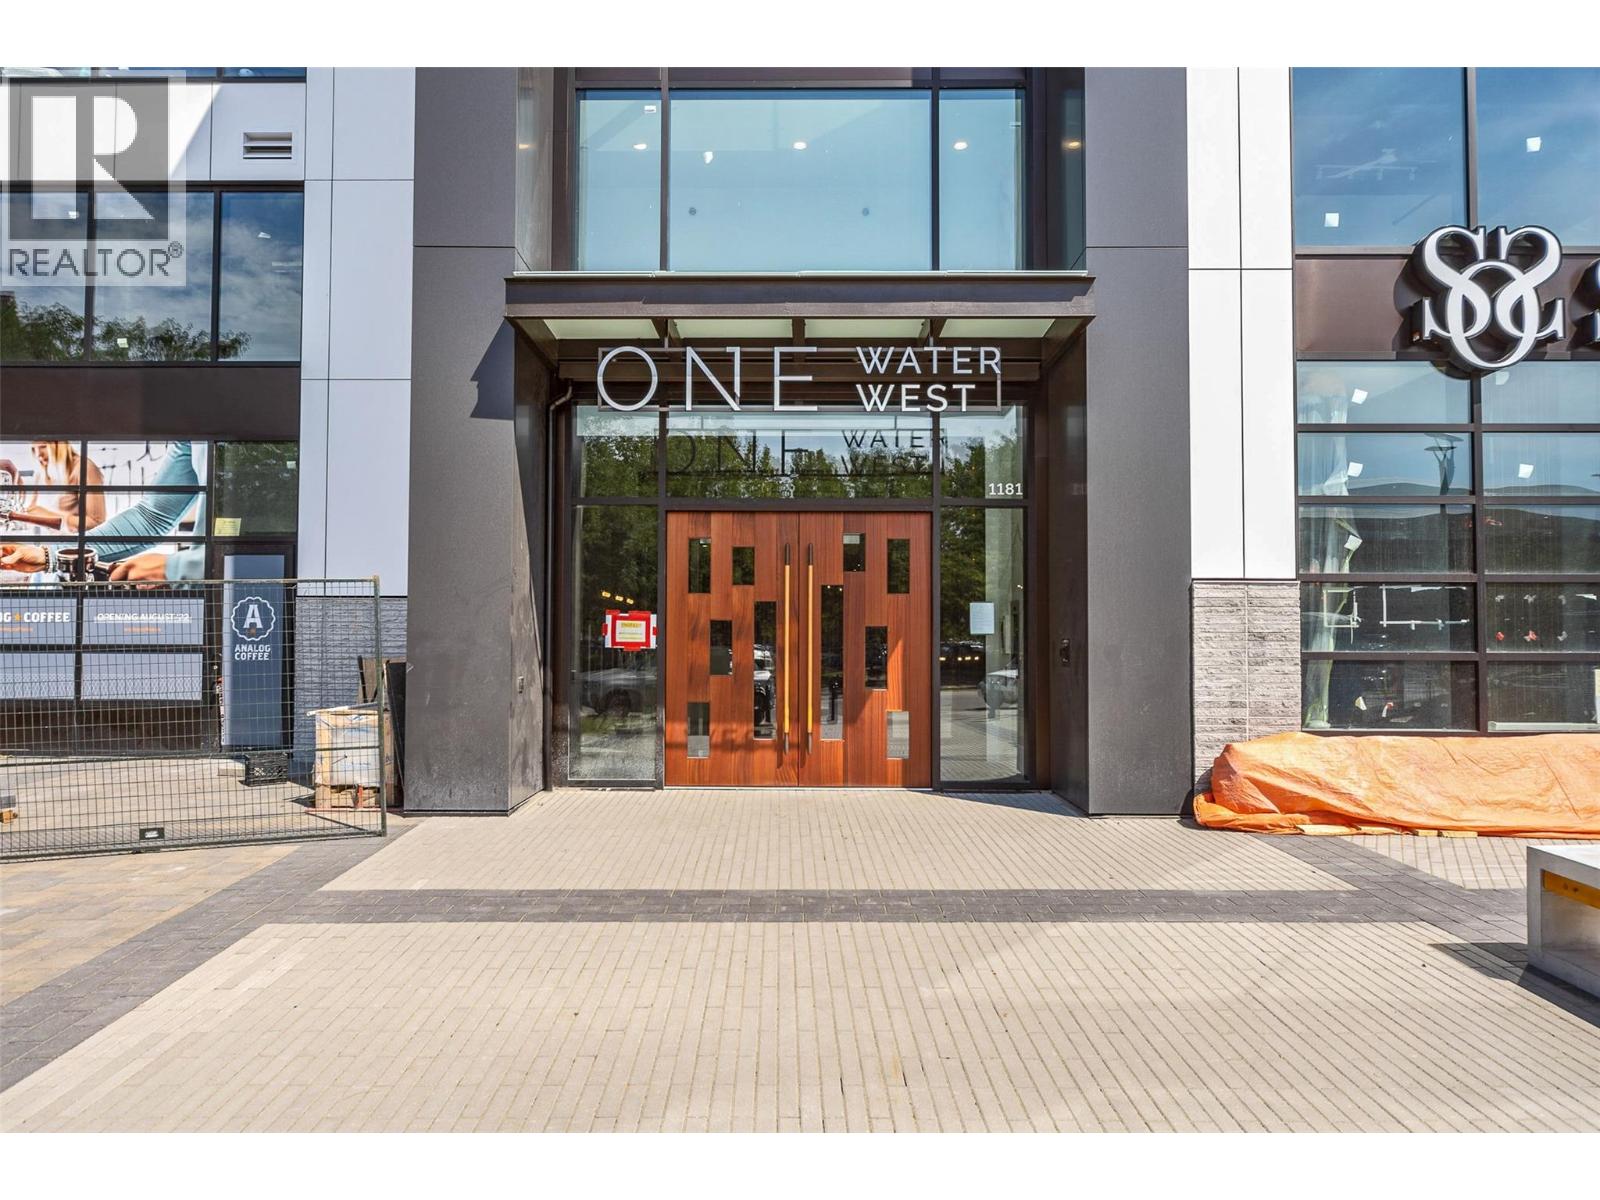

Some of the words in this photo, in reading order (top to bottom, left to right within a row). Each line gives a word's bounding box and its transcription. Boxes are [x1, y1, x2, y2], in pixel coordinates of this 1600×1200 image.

[856, 346, 1001, 375] WATER
[597, 345, 818, 412] ONE
[856, 384, 976, 413] WEST
[989, 482, 1024, 496] 1181
[23, 612, 71, 623] COFFEE
[97, 612, 139, 621] OPENING
[141, 612, 174, 621] AUGUST
[243, 604, 263, 629] A
[234, 644, 271, 653] ANALOG
[234, 652, 270, 661] COFFEE
